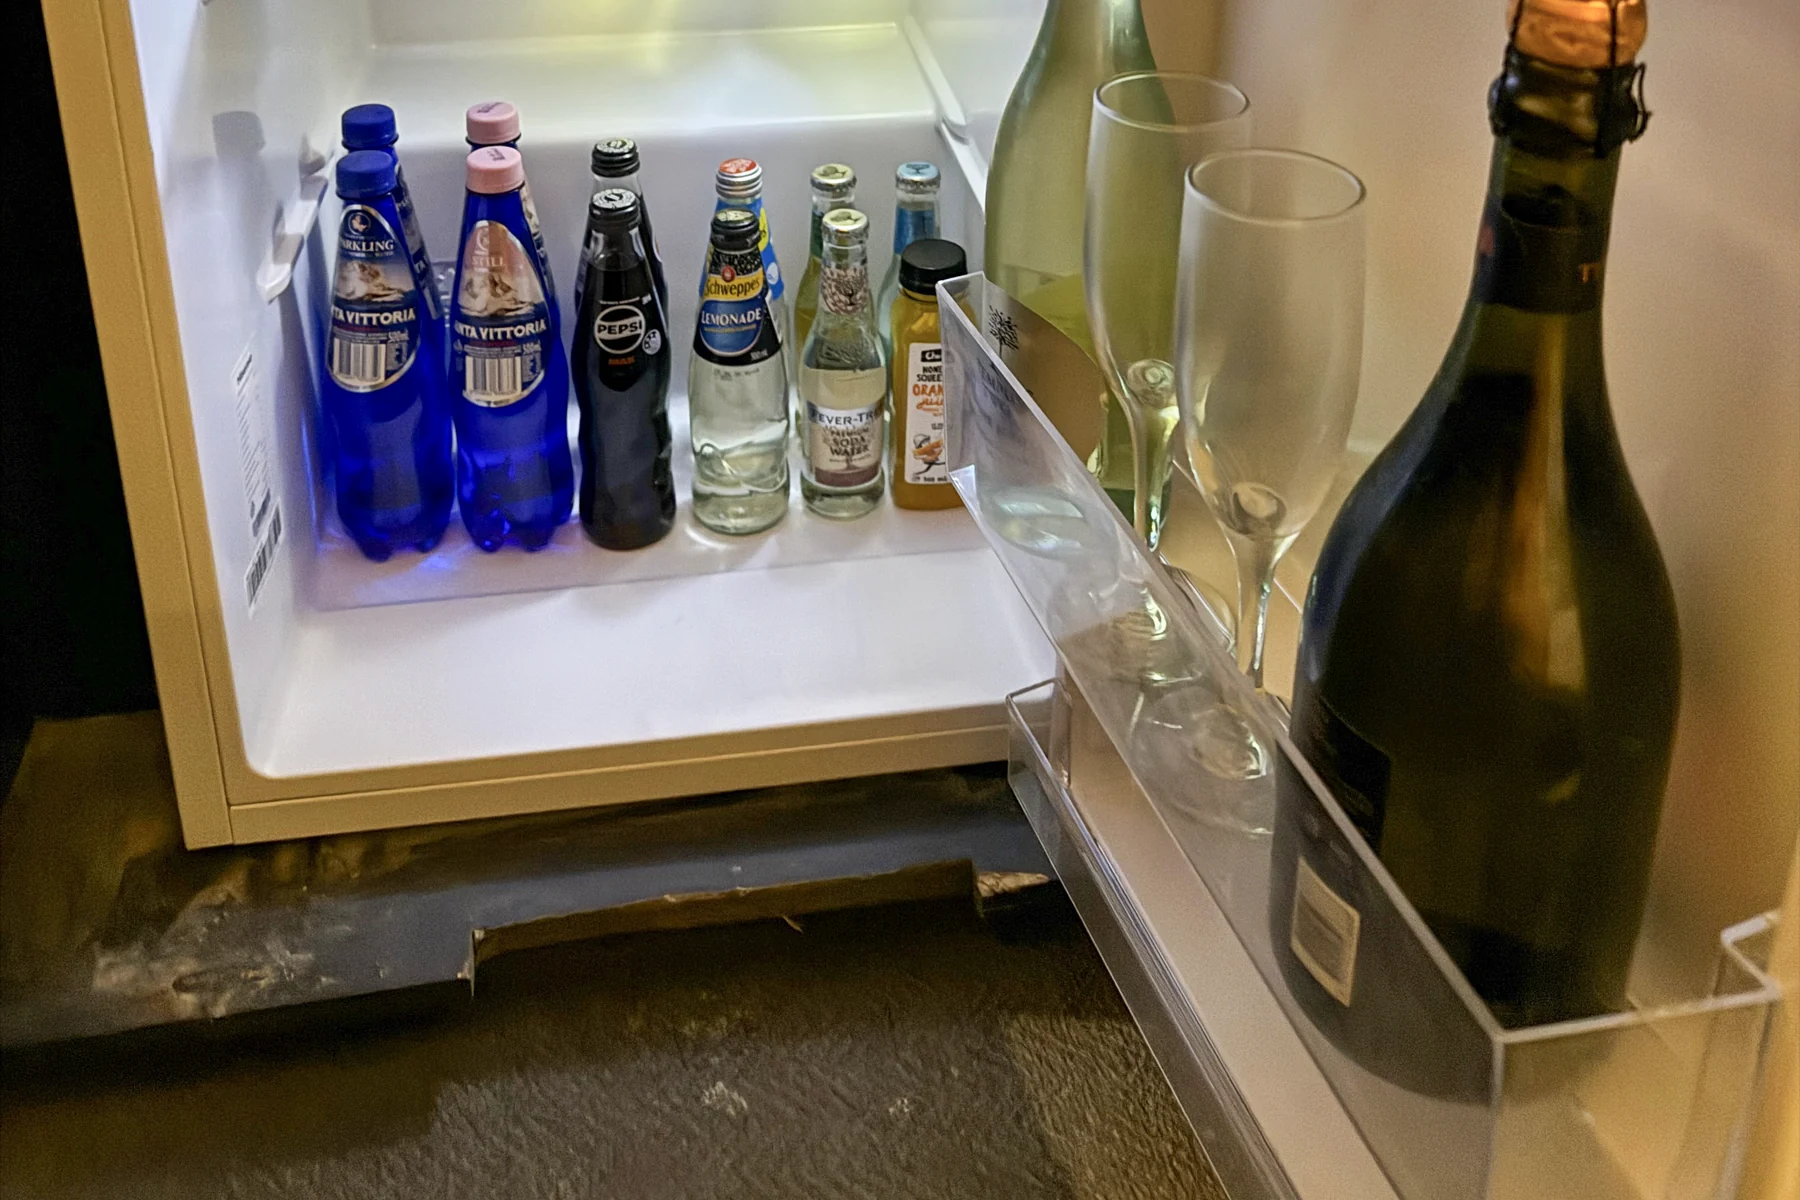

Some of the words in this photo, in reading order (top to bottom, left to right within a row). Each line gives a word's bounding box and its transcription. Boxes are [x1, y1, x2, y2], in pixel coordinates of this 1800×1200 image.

[704, 277, 761, 298] Schweppes
[345, 307, 416, 326] VITTORIA
[700, 307, 763, 327] LEMONADE
[478, 318, 547, 341] VITTORIA
[597, 319, 643, 335] PEPSI
[922, 365, 943, 374] HONE
[916, 373, 942, 382] SQUEE
[912, 383, 944, 397] ORAN
[831, 435, 867, 448] SODA
[829, 444, 870, 457] WATER
